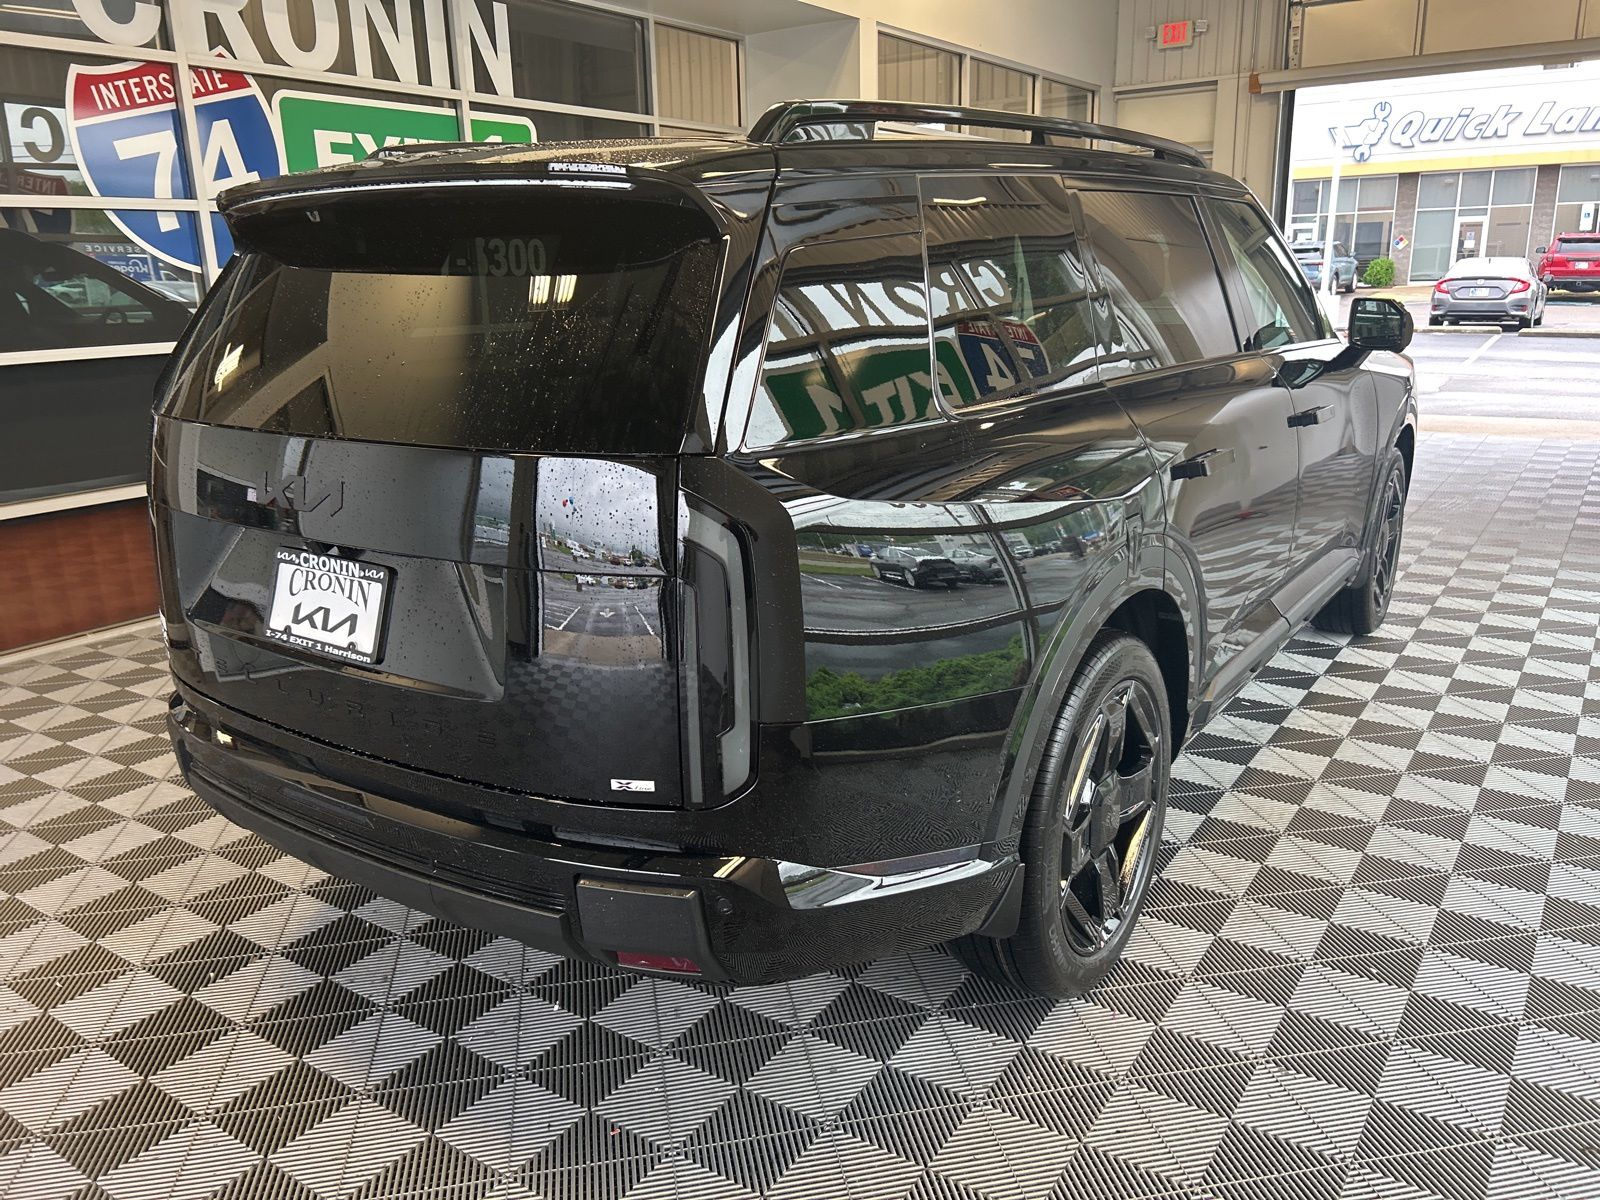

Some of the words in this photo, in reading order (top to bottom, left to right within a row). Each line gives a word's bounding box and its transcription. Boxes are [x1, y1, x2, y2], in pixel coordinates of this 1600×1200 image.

[90, 68, 229, 111] INTERSATE
[1390, 104, 1523, 148] Quick
[113, 118, 260, 232] 74
[300, 552, 360, 578] CRONIN
[289, 567, 373, 613] CRONIN
[291, 601, 359, 638] KIA
[265, 629, 288, 641] I-74
[289, 635, 314, 648] EXIT
[315, 643, 322, 651] 1
[324, 645, 371, 663] Harrison
